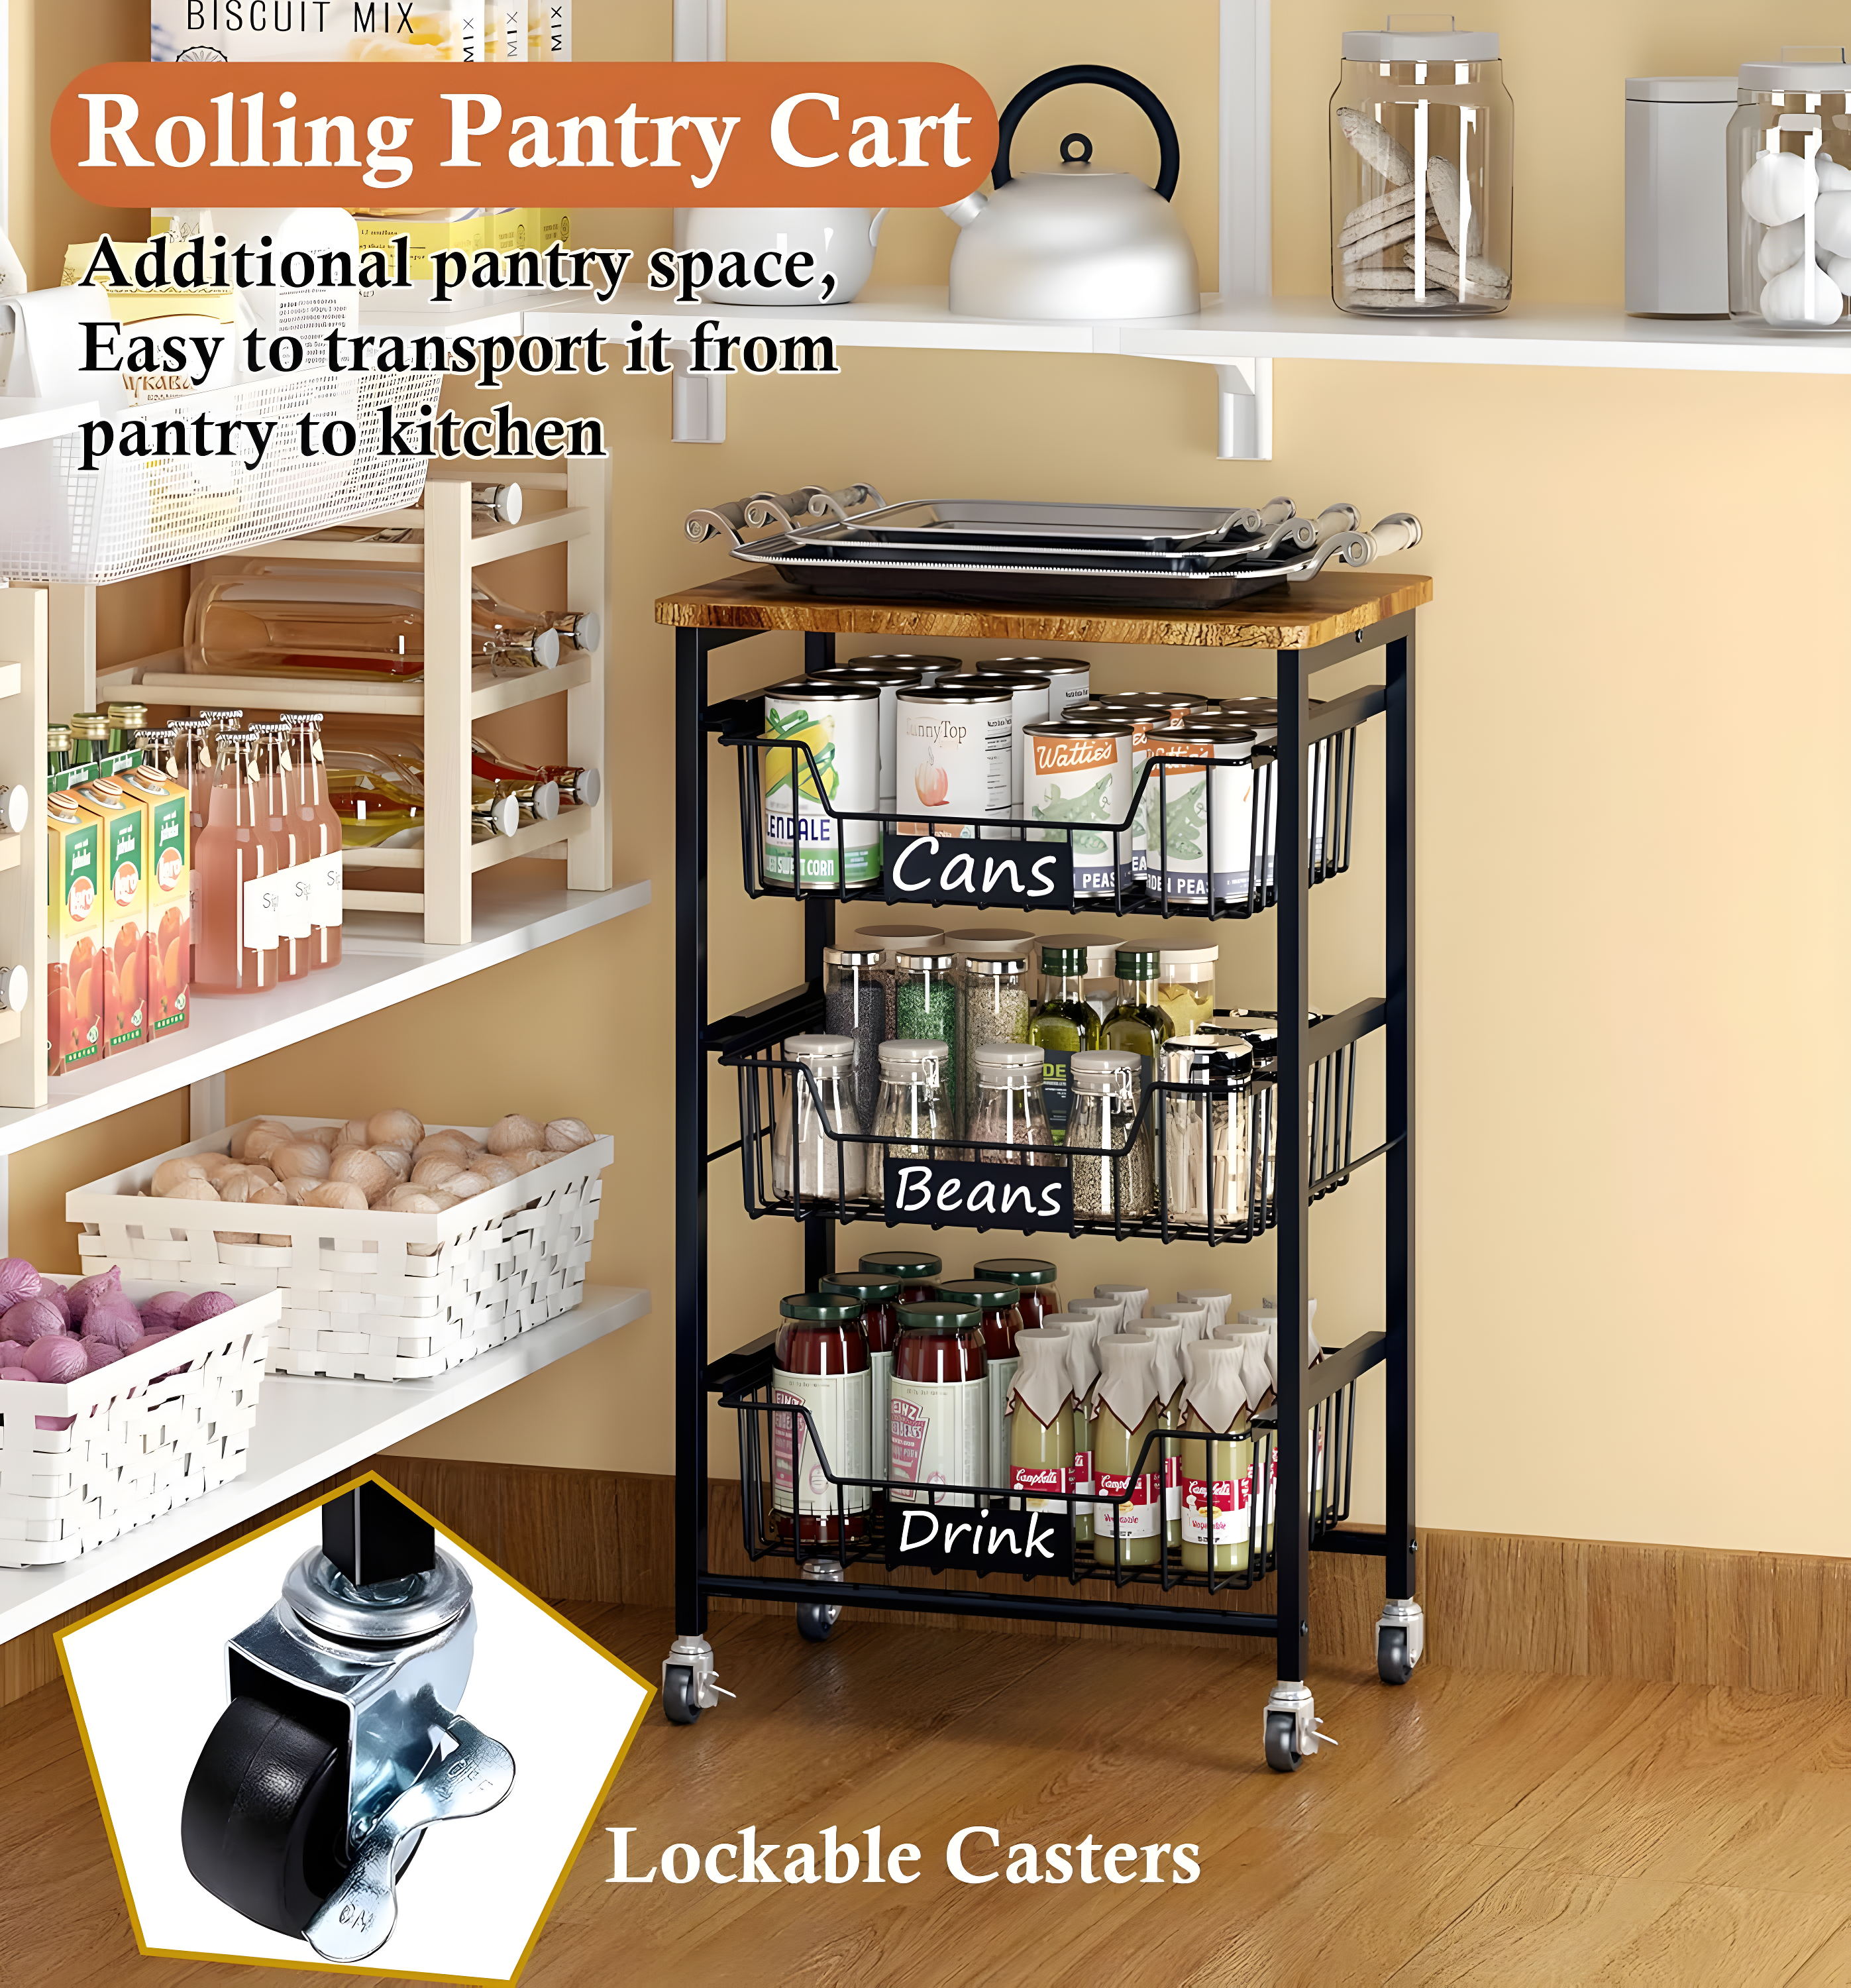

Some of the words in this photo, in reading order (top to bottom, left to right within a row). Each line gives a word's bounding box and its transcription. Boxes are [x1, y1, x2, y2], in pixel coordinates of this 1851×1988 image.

[187, 0, 331, 32] BISCUIT
[354, 2, 413, 34] MIX
[507, 12, 518, 57] MIX
[551, 6, 562, 52] MIX
[463, 18, 474, 62] MIX
[1037, 740, 1112, 769] Wattie's
[767, 815, 830, 841] ENDALE
[777, 857, 806, 875] SWET
[807, 859, 834, 876] CORN
[892, 836, 1057, 897] Cans
[896, 1166, 1062, 1217] Beans
[900, 1509, 1055, 1558] Drink
